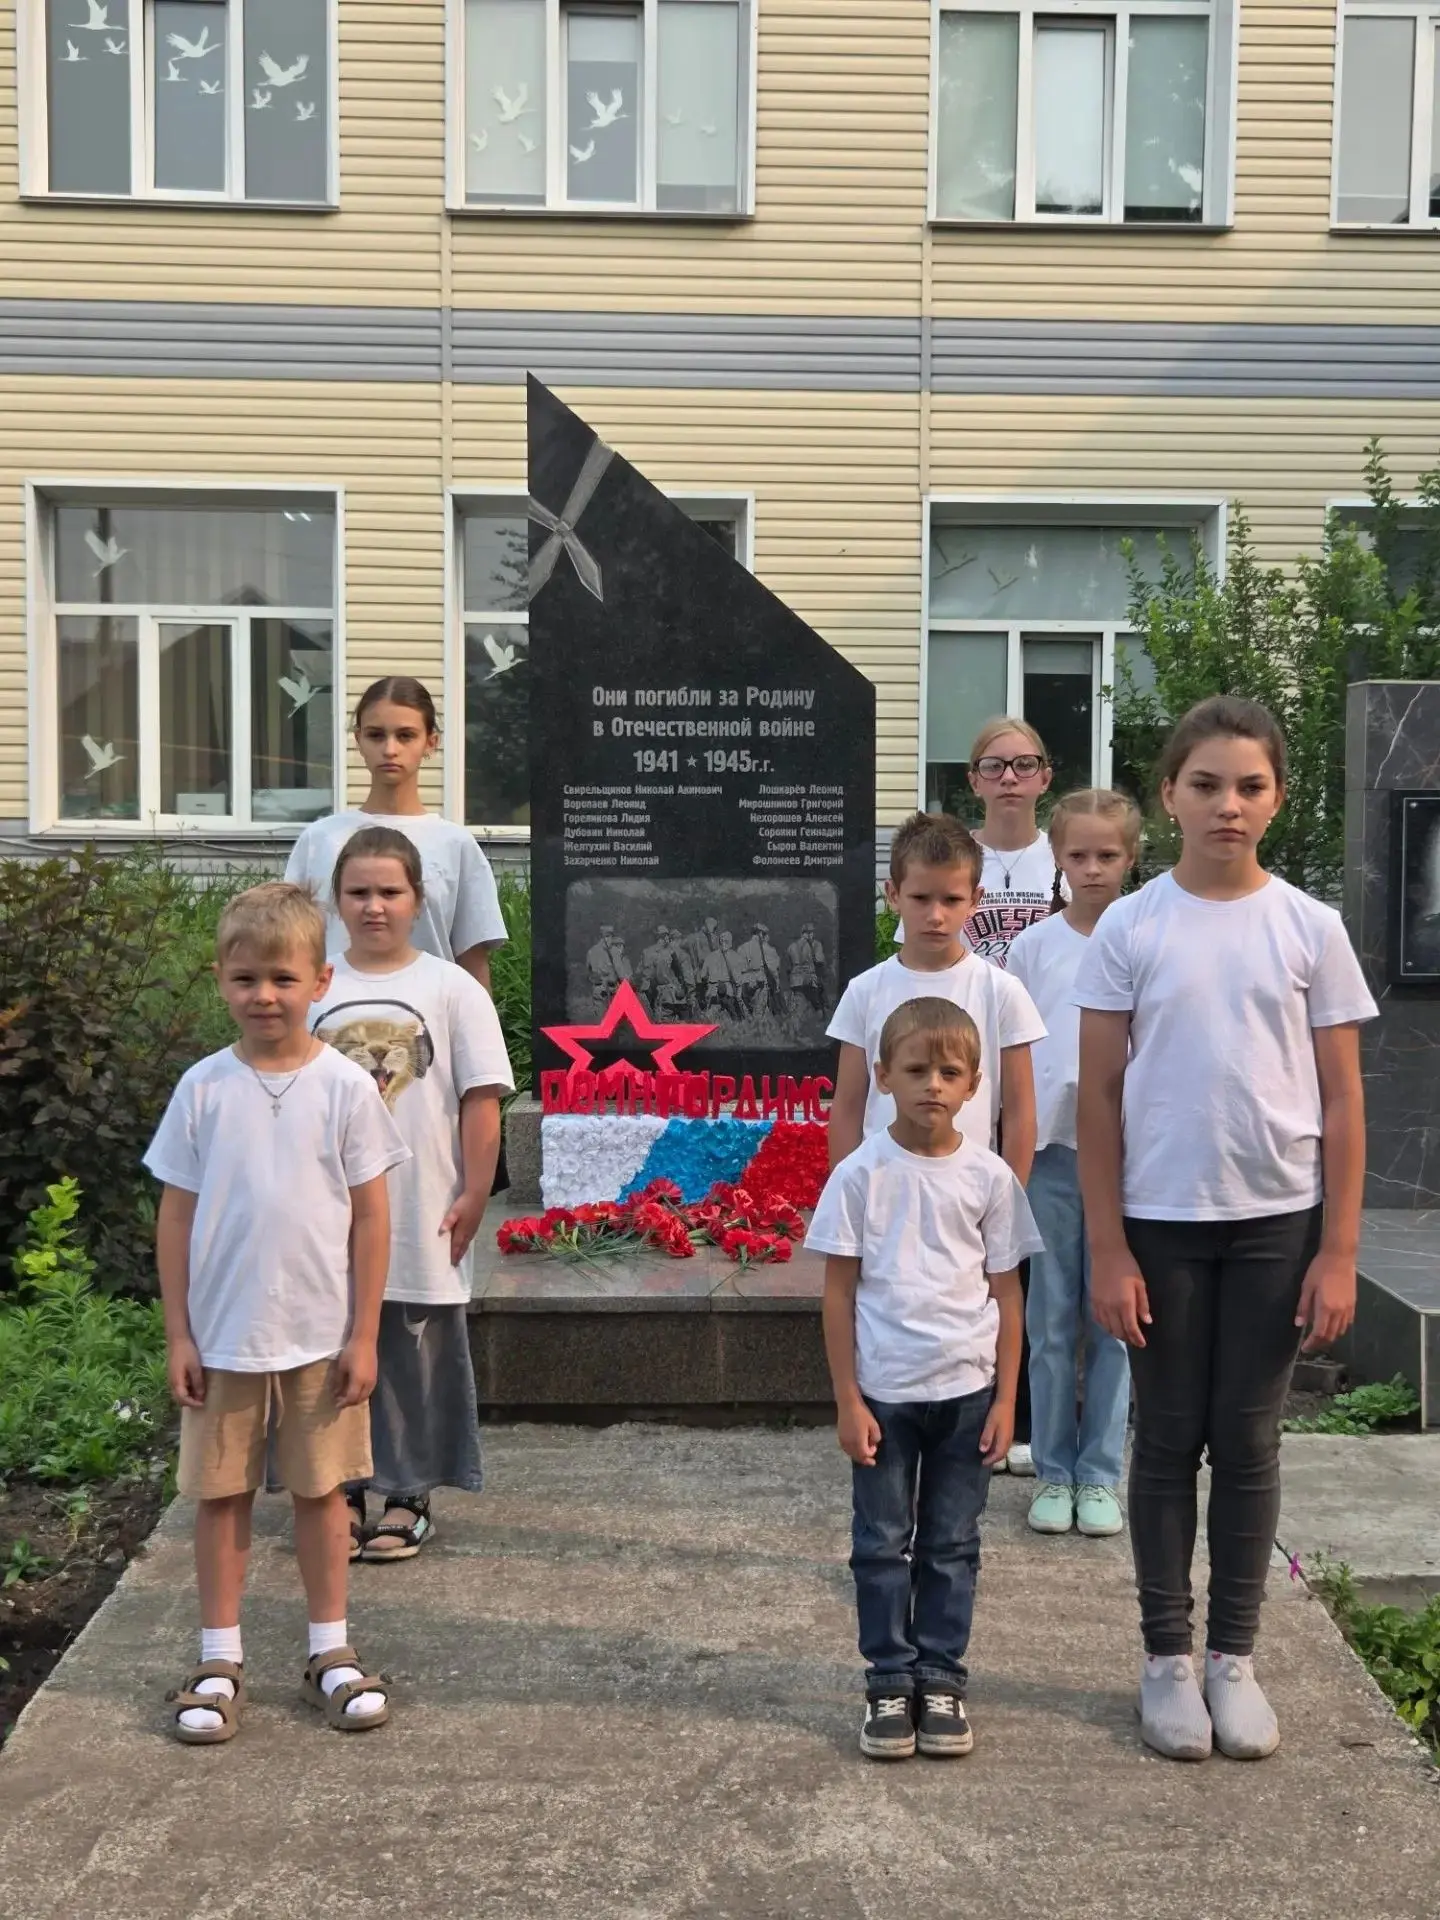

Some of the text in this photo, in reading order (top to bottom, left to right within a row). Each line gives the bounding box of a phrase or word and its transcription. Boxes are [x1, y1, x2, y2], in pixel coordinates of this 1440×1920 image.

[593, 686, 815, 710] Они погибли за Родину
[593, 717, 815, 737] в Отечественной войне
[633, 750, 678, 772] 1941
[635, 784, 675, 794] Николай
[677, 784, 723, 794] Акимович
[809, 784, 844, 795] Леонид
[611, 799, 647, 810] Леонид
[739, 798, 844, 810] Мирошников Григорий
[621, 813, 651, 824] Лидия
[805, 813, 844, 823] Алексей
[606, 827, 645, 837] Николай
[759, 827, 844, 838] Сорокин Геннадий
[563, 841, 653, 853] Желтухин Василий
[767, 841, 844, 852] Сыров Валентин
[563, 855, 660, 866] Захарченко Николай
[803, 855, 844, 866] Дмитрий
